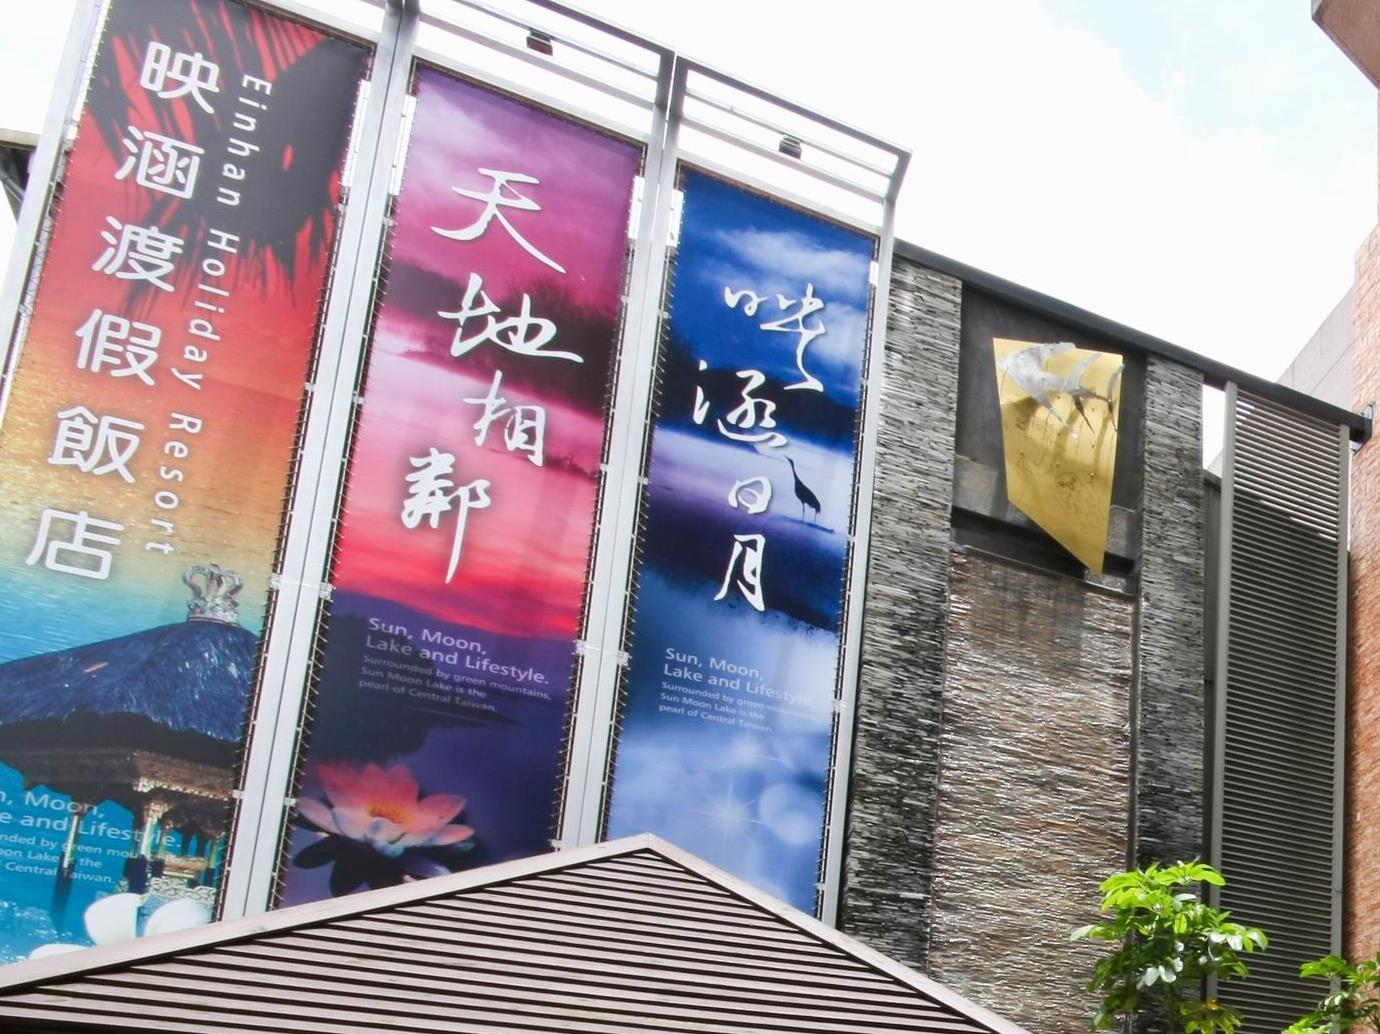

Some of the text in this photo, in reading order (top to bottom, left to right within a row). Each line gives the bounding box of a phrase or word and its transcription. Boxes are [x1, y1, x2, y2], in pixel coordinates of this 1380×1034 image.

[26, 41, 221, 580] 映涵渡假飯店
[144, 73, 272, 555] Einhan Holiday Resort
[369, 617, 487, 655] Sun, Moon,
[363, 655, 433, 675] Surrounded
[436, 668, 450, 680] by
[453, 674, 487, 687] green
[366, 635, 550, 685] Lake and Lifestyle.
[664, 648, 764, 681] Sun, Moon,
[361, 666, 384, 678] Sun
[387, 671, 422, 686] Moon
[468, 688, 488, 699] the
[661, 681, 720, 700] Surrounded
[664, 663, 703, 682] Lake
[708, 674, 740, 691] and
[659, 704, 685, 715] pearl
[660, 692, 680, 703] Sun
[682, 696, 712, 710] Moon
[25, 791, 104, 818] Moon,
[20, 815, 69, 832] and
[40, 836, 57, 851] by
[6, 861, 57, 876] Central
[80, 857, 103, 868] the
